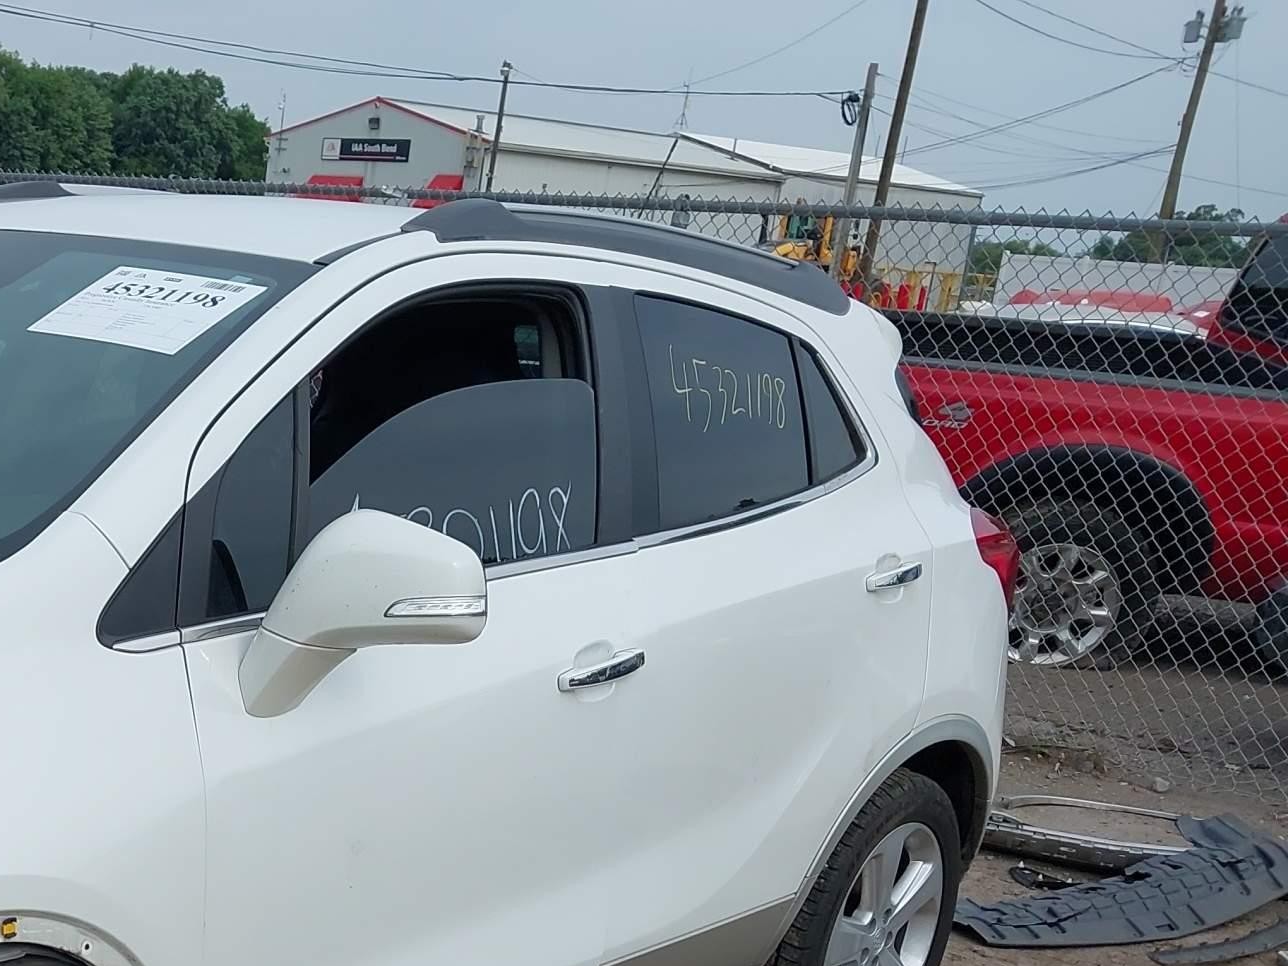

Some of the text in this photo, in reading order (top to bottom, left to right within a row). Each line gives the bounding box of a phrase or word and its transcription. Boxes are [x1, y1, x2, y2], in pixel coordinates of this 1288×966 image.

[364, 143, 381, 153] South
[381, 143, 398, 153] Bend
[101, 281, 226, 308] 45321198
[669, 344, 786, 433] 45321198
